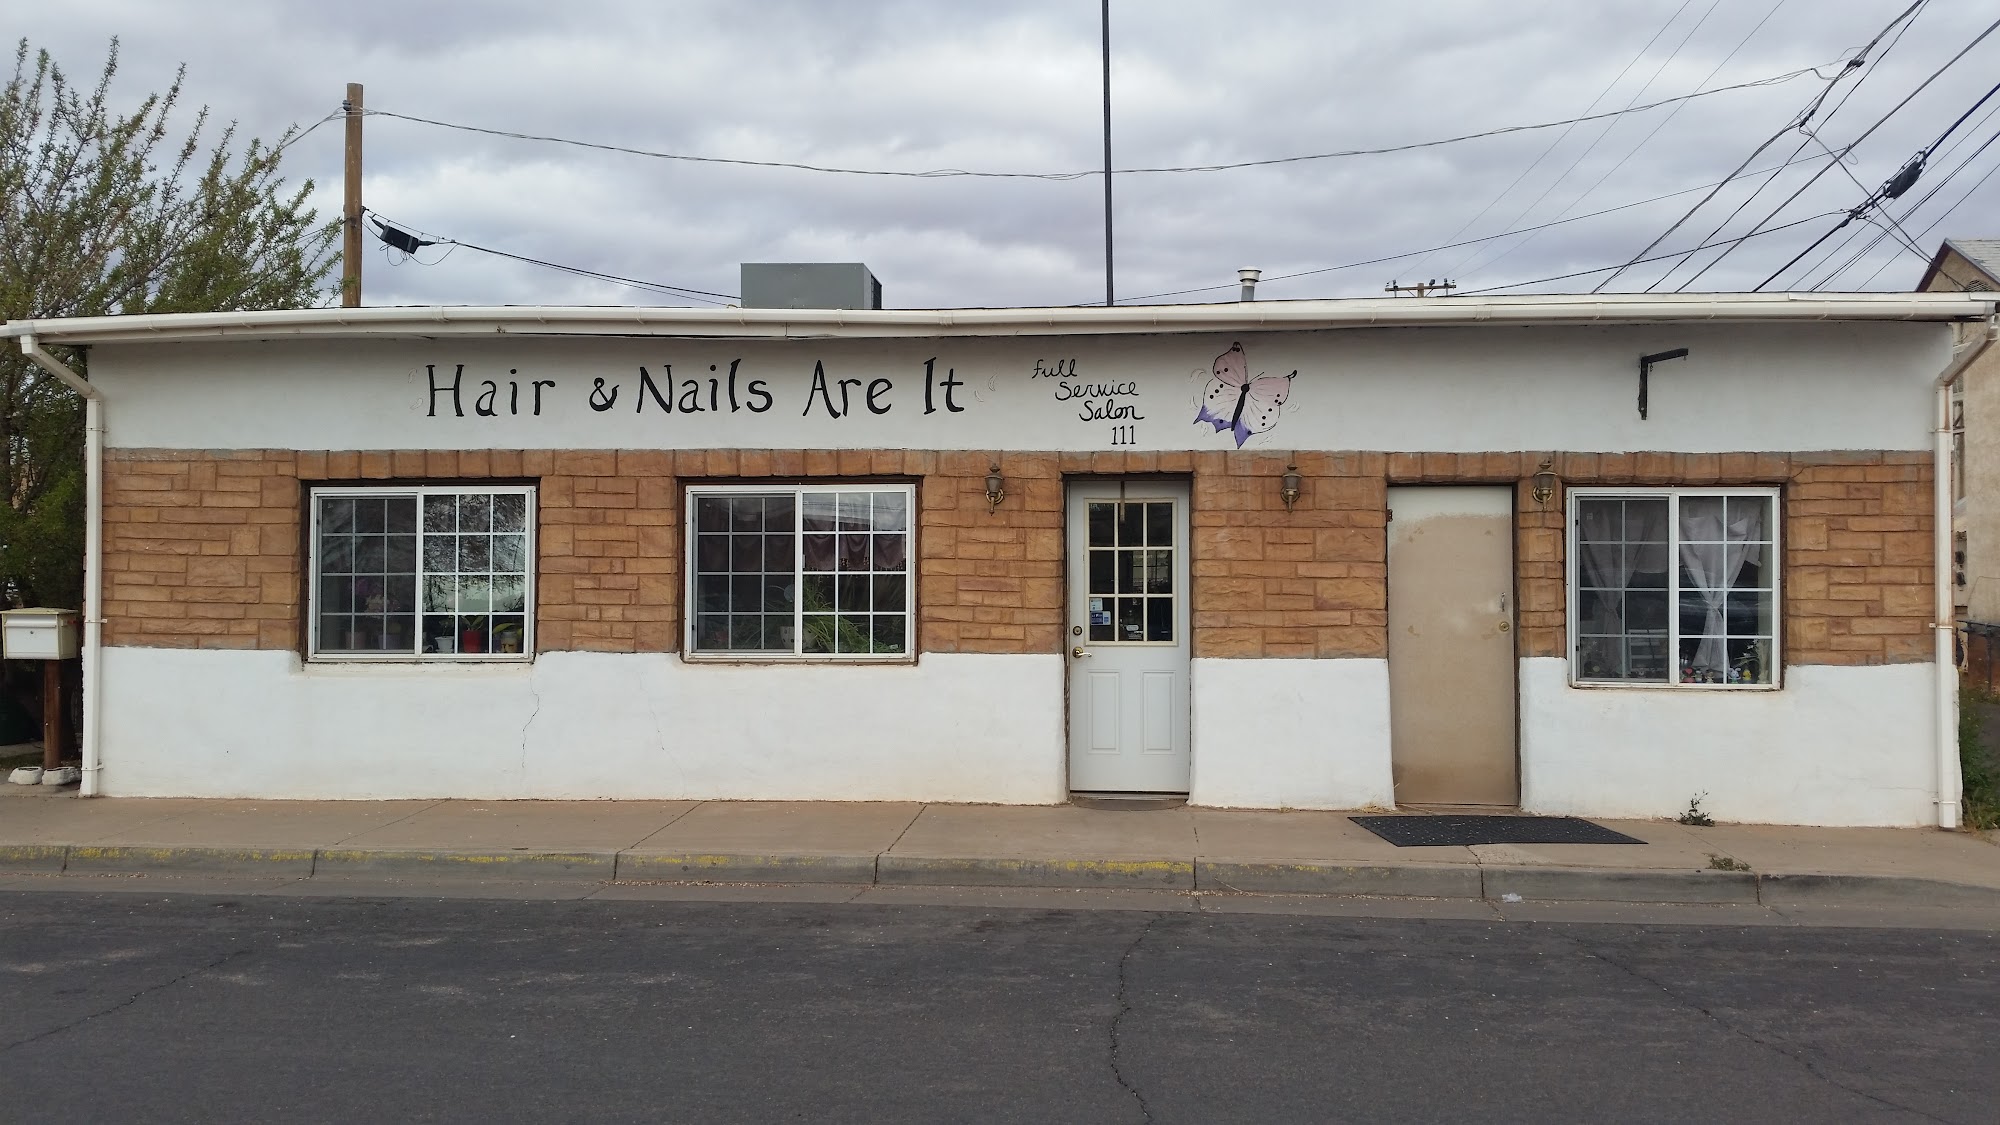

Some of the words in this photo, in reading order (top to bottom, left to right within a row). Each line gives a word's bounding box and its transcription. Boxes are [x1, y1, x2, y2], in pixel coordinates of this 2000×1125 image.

[426, 364, 556, 418] Hair
[588, 377, 620, 413] &
[636, 358, 774, 415] Nails
[802, 360, 893, 420] Are
[923, 357, 965, 416] It
[1055, 380, 1140, 401] Service
[1079, 399, 1145, 422] Salon
[1111, 425, 1137, 446] 111
